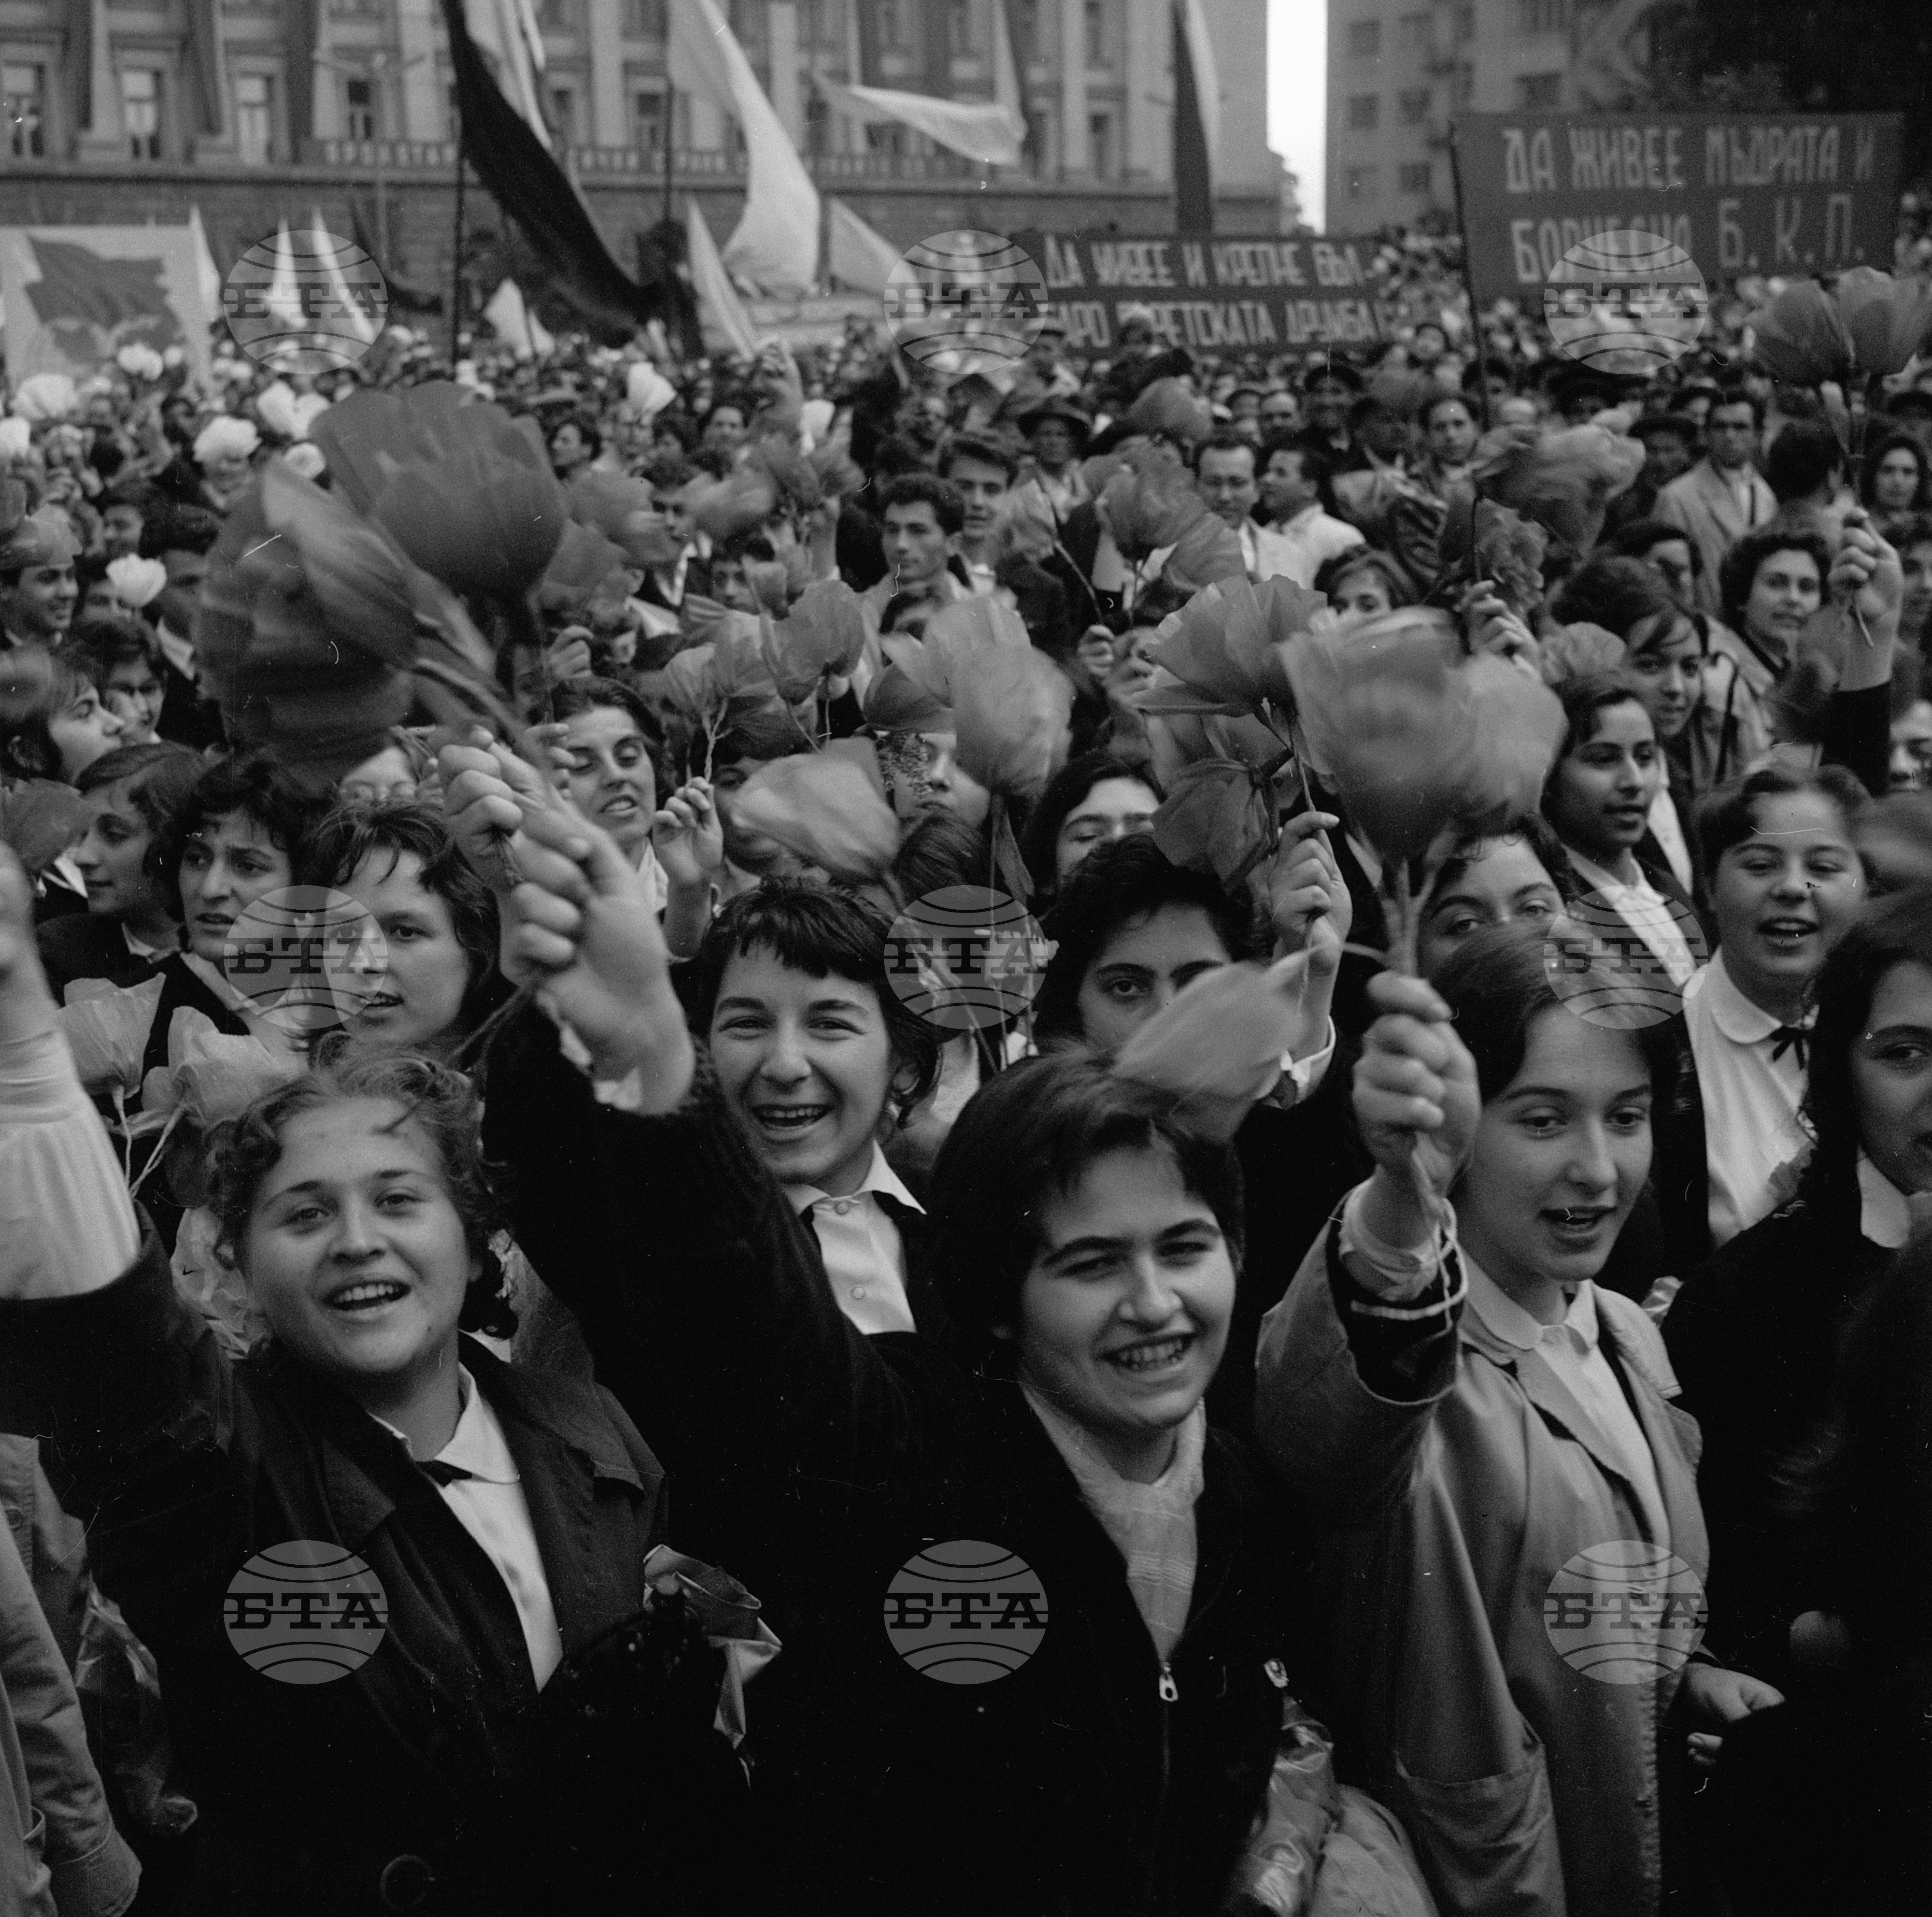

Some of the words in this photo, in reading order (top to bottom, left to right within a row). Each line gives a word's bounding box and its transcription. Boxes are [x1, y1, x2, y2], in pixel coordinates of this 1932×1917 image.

[1502, 128, 1557, 193] ДА
[1568, 127, 1687, 190] ЖИВЕЕ
[1705, 126, 1839, 186] МЪДРАТА
[1854, 127, 1874, 182] И
[1044, 235, 1086, 288] ДА
[1091, 242, 1177, 287] ЖИВЕЕ
[1182, 242, 1208, 288] И
[1718, 198, 1759, 268] Б.
[1775, 197, 1815, 263] К.
[1826, 193, 1864, 260] П.
